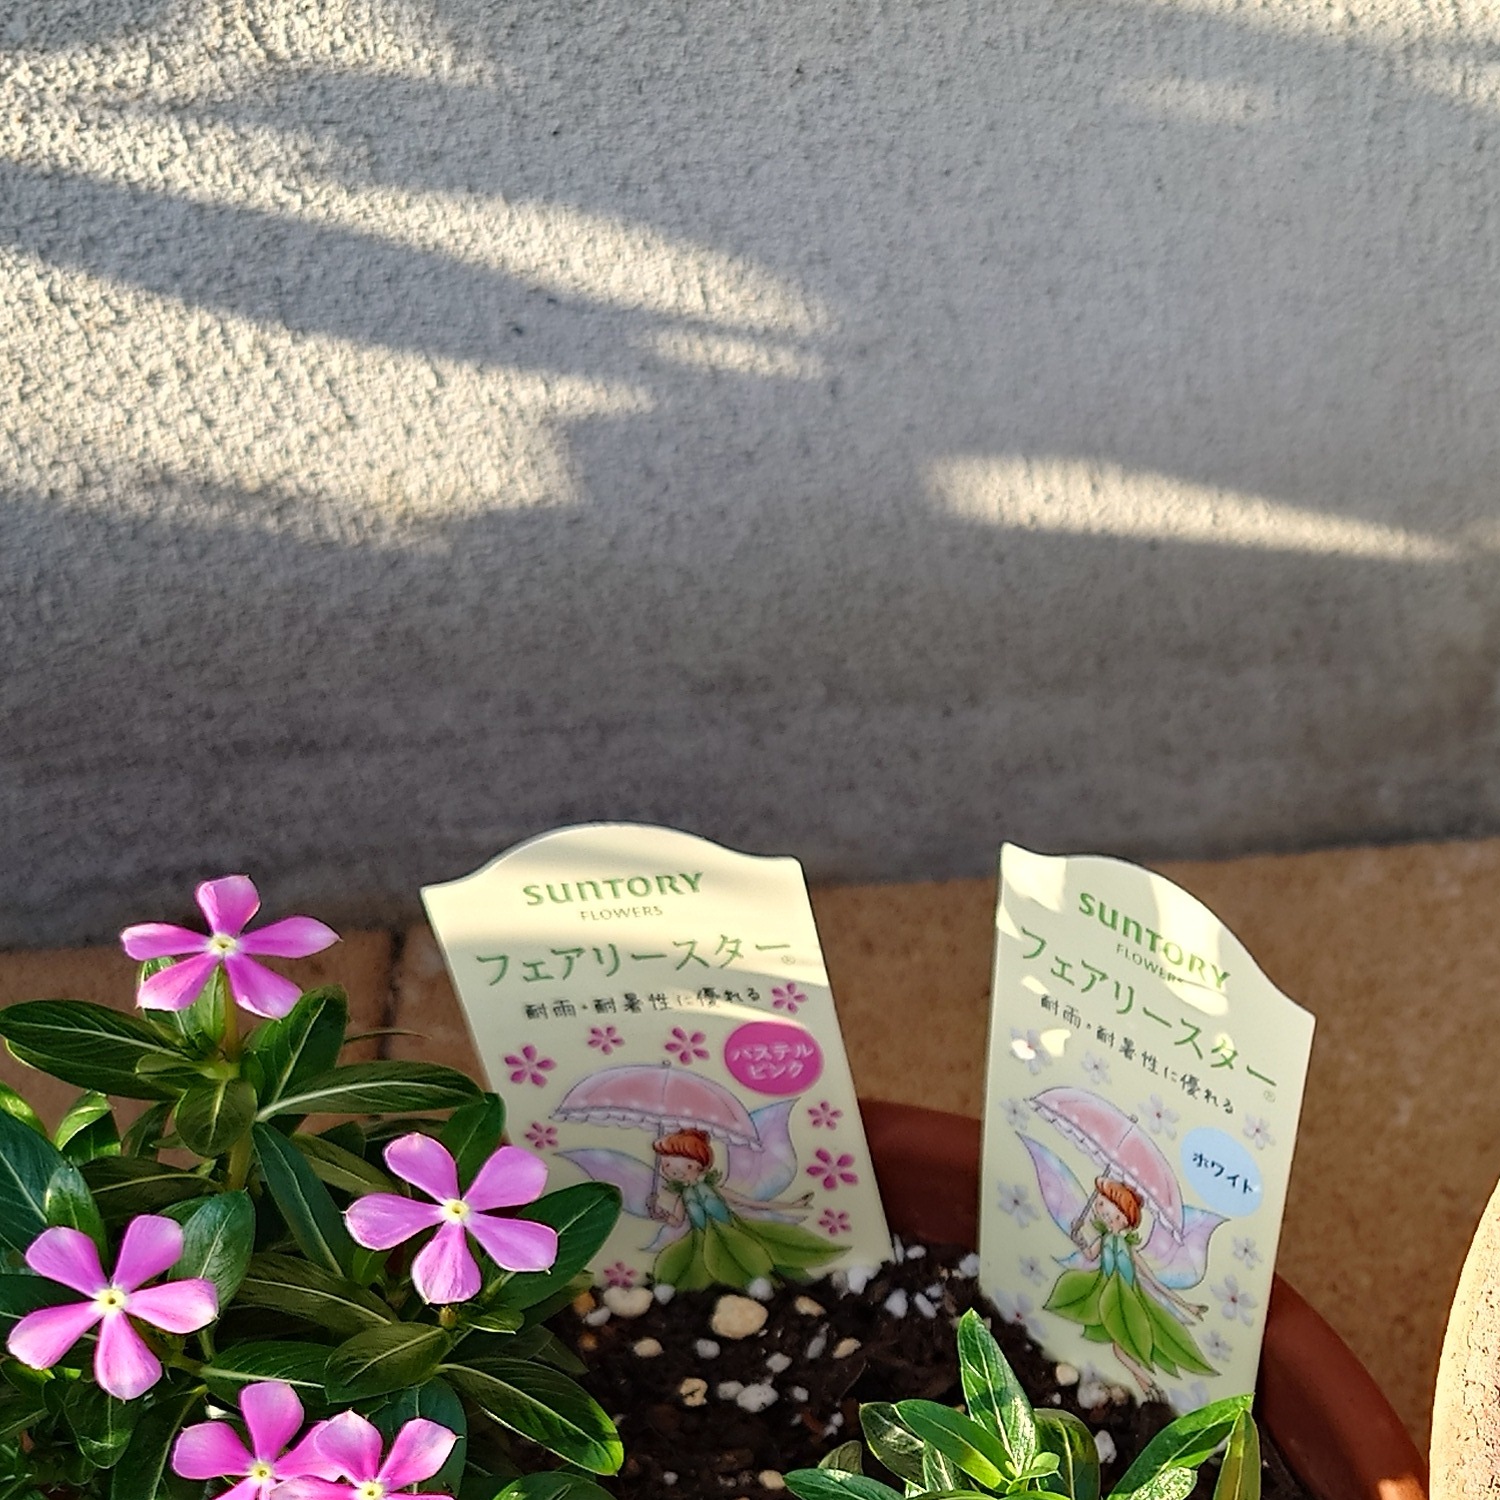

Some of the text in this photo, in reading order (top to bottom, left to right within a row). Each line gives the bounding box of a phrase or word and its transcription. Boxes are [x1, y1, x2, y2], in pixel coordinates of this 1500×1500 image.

[522, 871, 704, 906] SUNTORY
[580, 905, 663, 921] FLOWERS
[476, 933, 792, 986] フェアリースター
[1079, 892, 1231, 990] SUNTORY
[1020, 926, 1277, 1088] フェアリースター
[731, 1041, 815, 1063] パステル
[749, 1060, 804, 1081] ピンク
[1192, 1152, 1255, 1196] ホワイト
